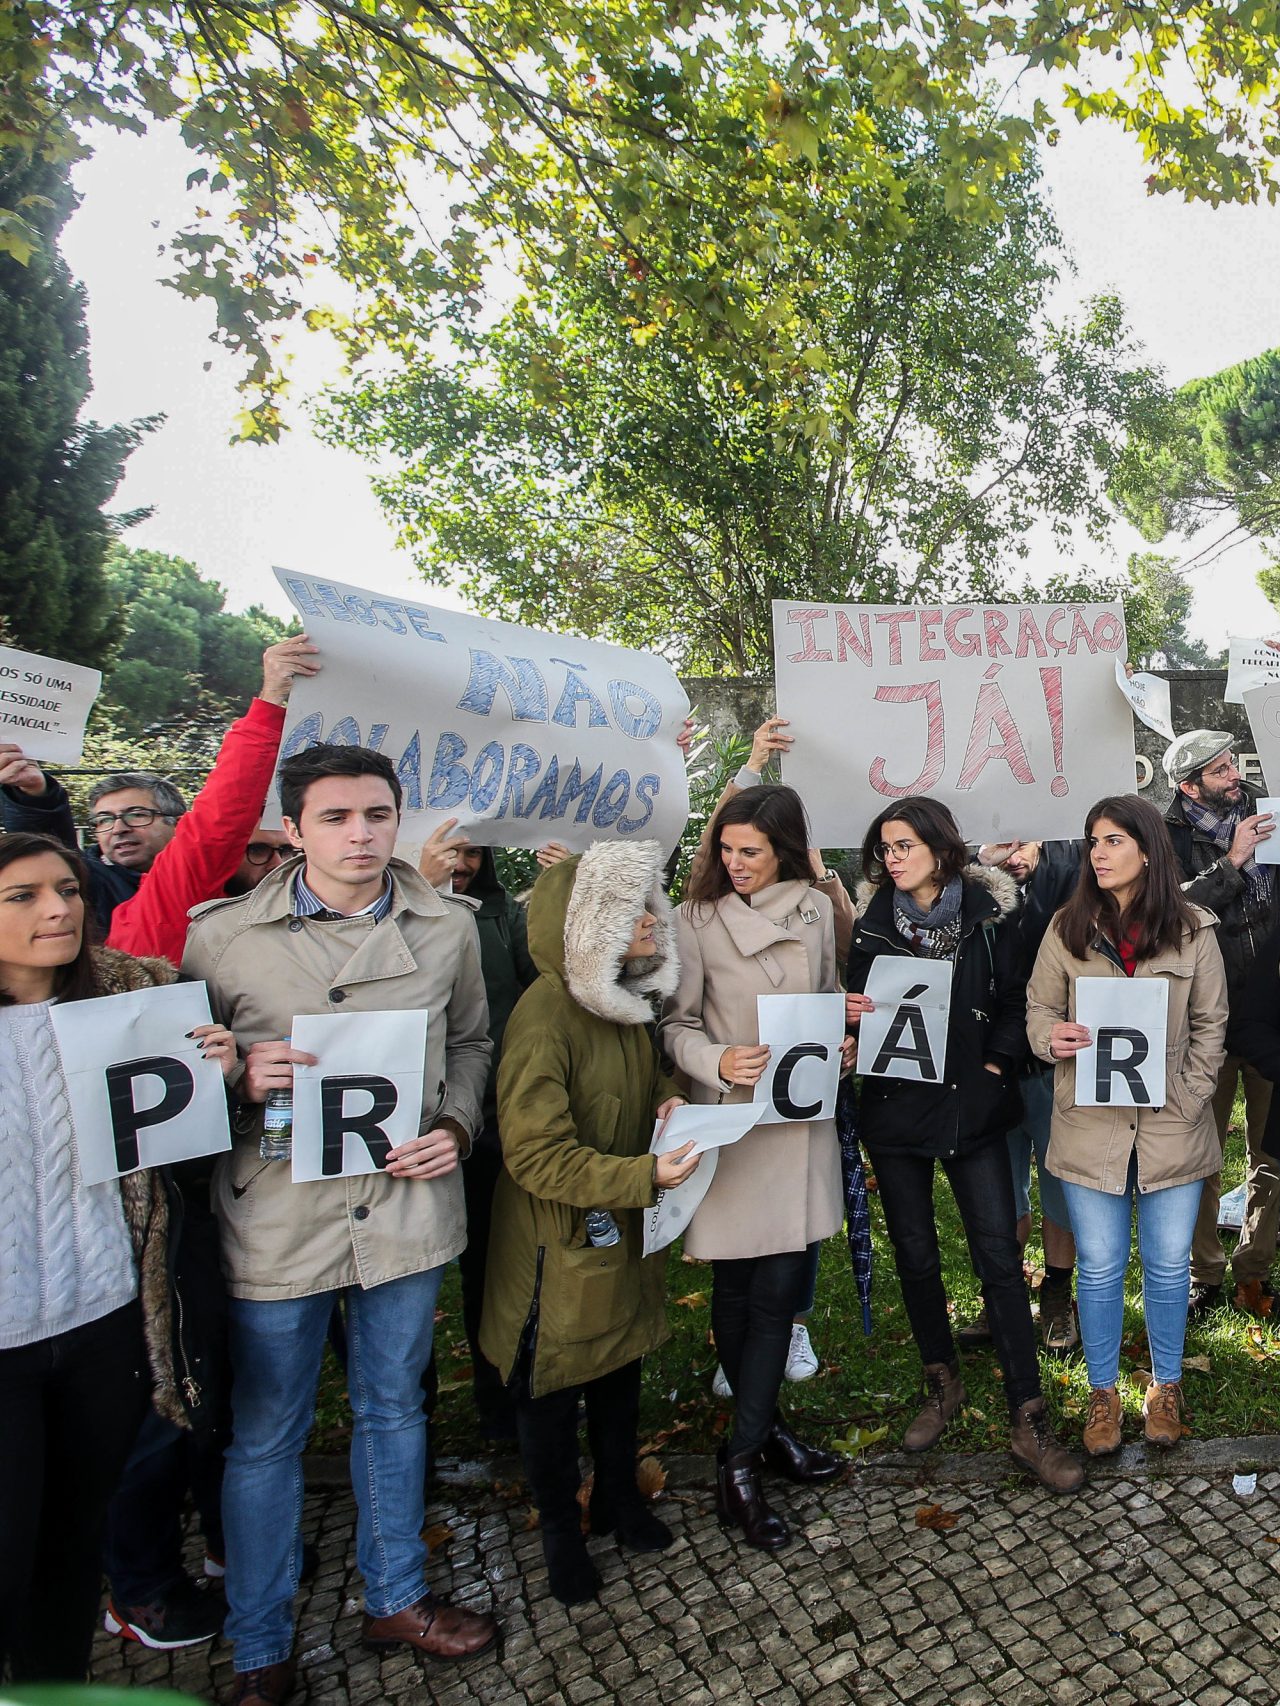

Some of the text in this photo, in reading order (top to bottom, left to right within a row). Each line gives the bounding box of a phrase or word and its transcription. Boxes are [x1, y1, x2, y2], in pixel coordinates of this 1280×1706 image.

[285, 577, 449, 644] HOJE
[786, 603, 1126, 667] INTEGRAÇÃO
[0, 689, 63, 713] ESSIDADE
[23, 671, 43, 685] SÓ
[45, 676, 73, 693] UMA
[455, 647, 664, 742] NÃO
[867, 663, 1071, 798] JÁ!
[870, 982, 938, 1081] Á
[1094, 1025, 1153, 1104] R
[104, 1054, 195, 1174] P
[771, 1041, 829, 1121] C
[320, 1072, 400, 1178] R
[649, 1190, 666, 1233] COLAB
